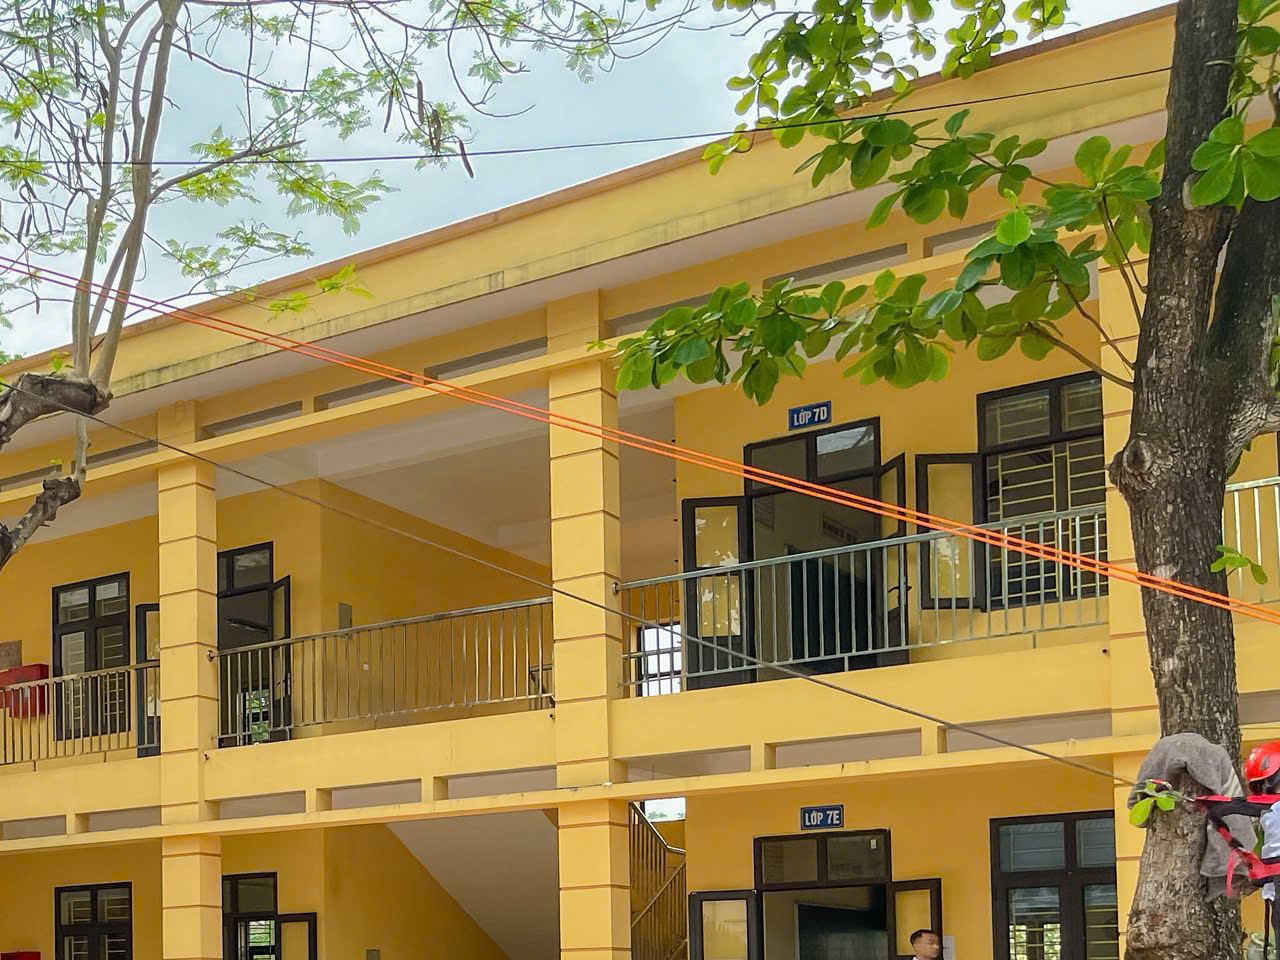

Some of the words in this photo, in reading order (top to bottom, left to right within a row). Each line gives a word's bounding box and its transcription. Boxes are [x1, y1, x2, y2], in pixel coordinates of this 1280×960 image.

[813, 406, 828, 422] 7D
[805, 810, 824, 826] LỚP
[826, 810, 840, 825] 7E
